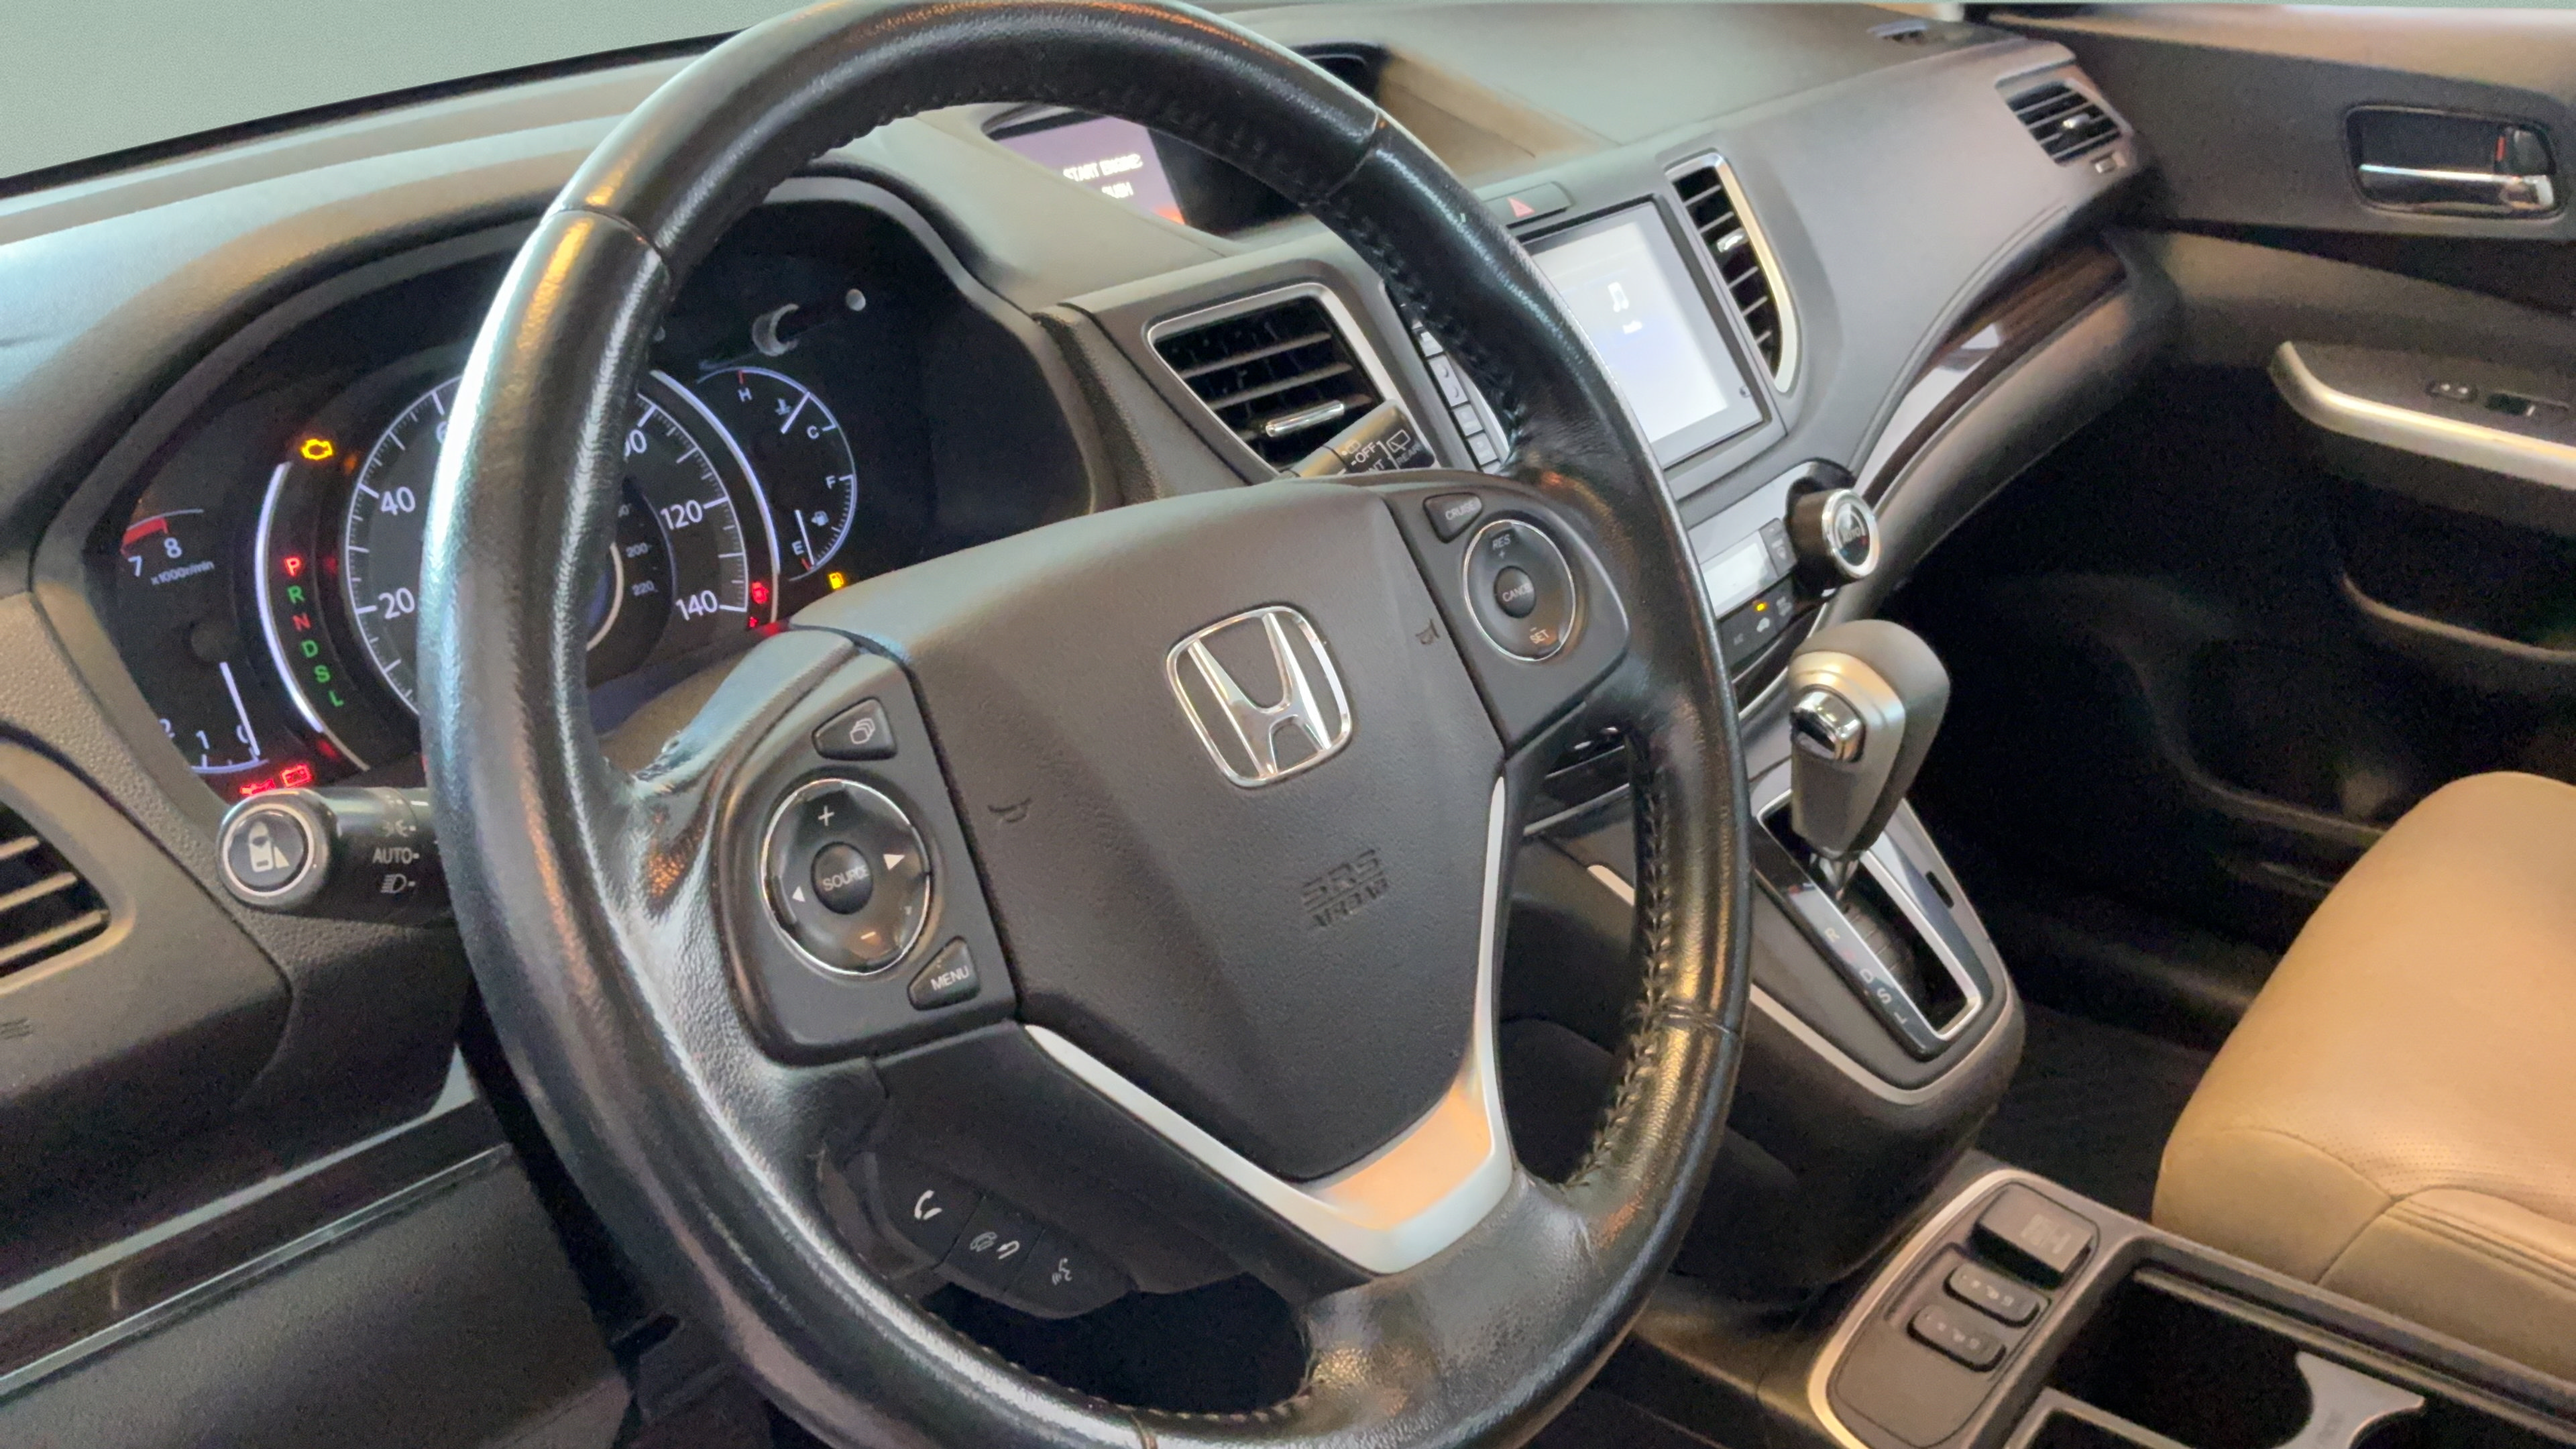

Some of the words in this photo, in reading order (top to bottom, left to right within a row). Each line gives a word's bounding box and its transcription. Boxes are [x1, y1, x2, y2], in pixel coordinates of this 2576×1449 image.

[738, 388, 752, 402] H
[807, 426, 820, 439] C
[1355, 441, 1376, 463] OFF
[826, 475, 836, 489] F
[381, 486, 416, 515] 40
[661, 500, 702, 530] 120
[1445, 500, 1476, 521] CRUISE
[164, 537, 182, 558] 8
[626, 542, 649, 558] 200
[792, 541, 804, 555] E
[1492, 534, 1511, 549] RES
[127, 555, 142, 577] 7
[285, 557, 301, 577] P
[288, 585, 304, 603] R
[378, 588, 414, 619] 20
[676, 590, 718, 621] 140
[292, 612, 311, 631] N
[1530, 629, 1549, 644] SET
[302, 640, 318, 657] D
[314, 664, 331, 683] S
[329, 690, 344, 706] L
[372, 847, 413, 864] AUTO
[823, 865, 869, 892] SOURCE
[931, 966, 969, 991] MENU
[1877, 988, 1892, 1004] S
